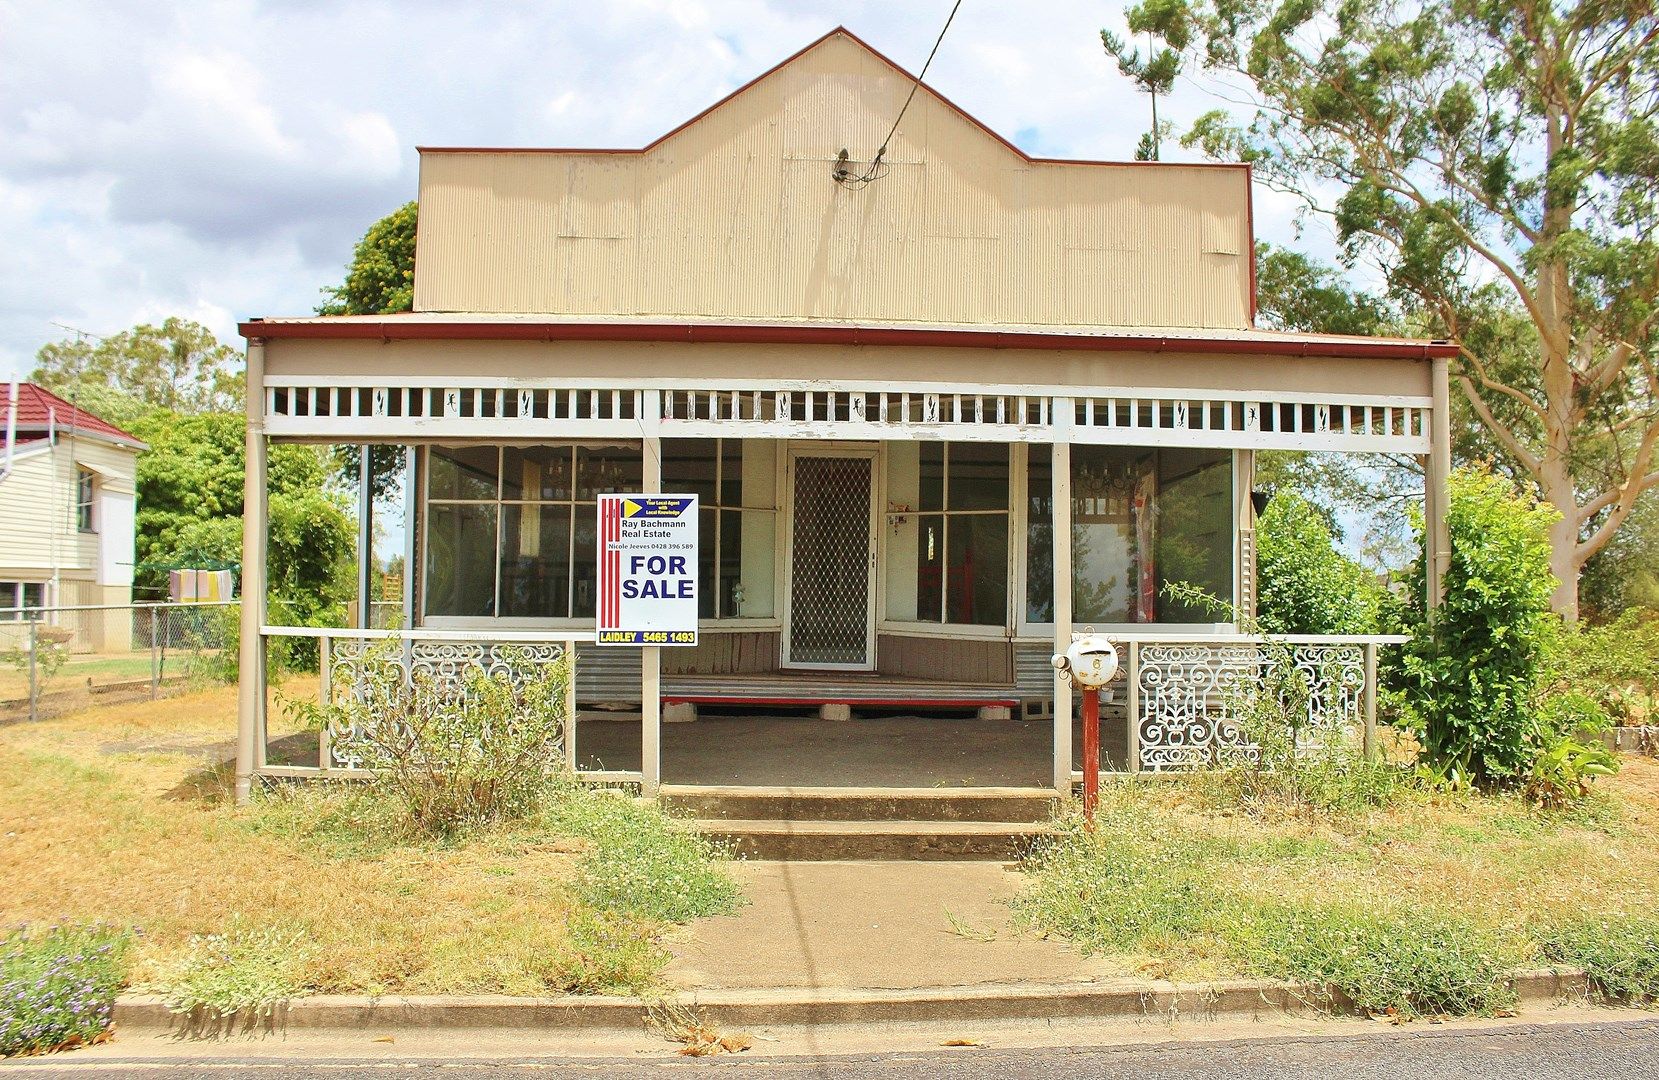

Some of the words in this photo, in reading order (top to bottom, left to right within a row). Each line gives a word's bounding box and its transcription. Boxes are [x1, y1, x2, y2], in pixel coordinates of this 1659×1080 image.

[622, 520, 638, 529] Ray
[640, 519, 686, 528] Bachmann
[622, 530, 641, 538] Real
[643, 530, 671, 538] Estate
[631, 555, 687, 575] FOR
[622, 579, 694, 599] SALE
[600, 632, 637, 642] LAIDLEY
[643, 632, 668, 642] 5465
[670, 632, 695, 642] 1493
